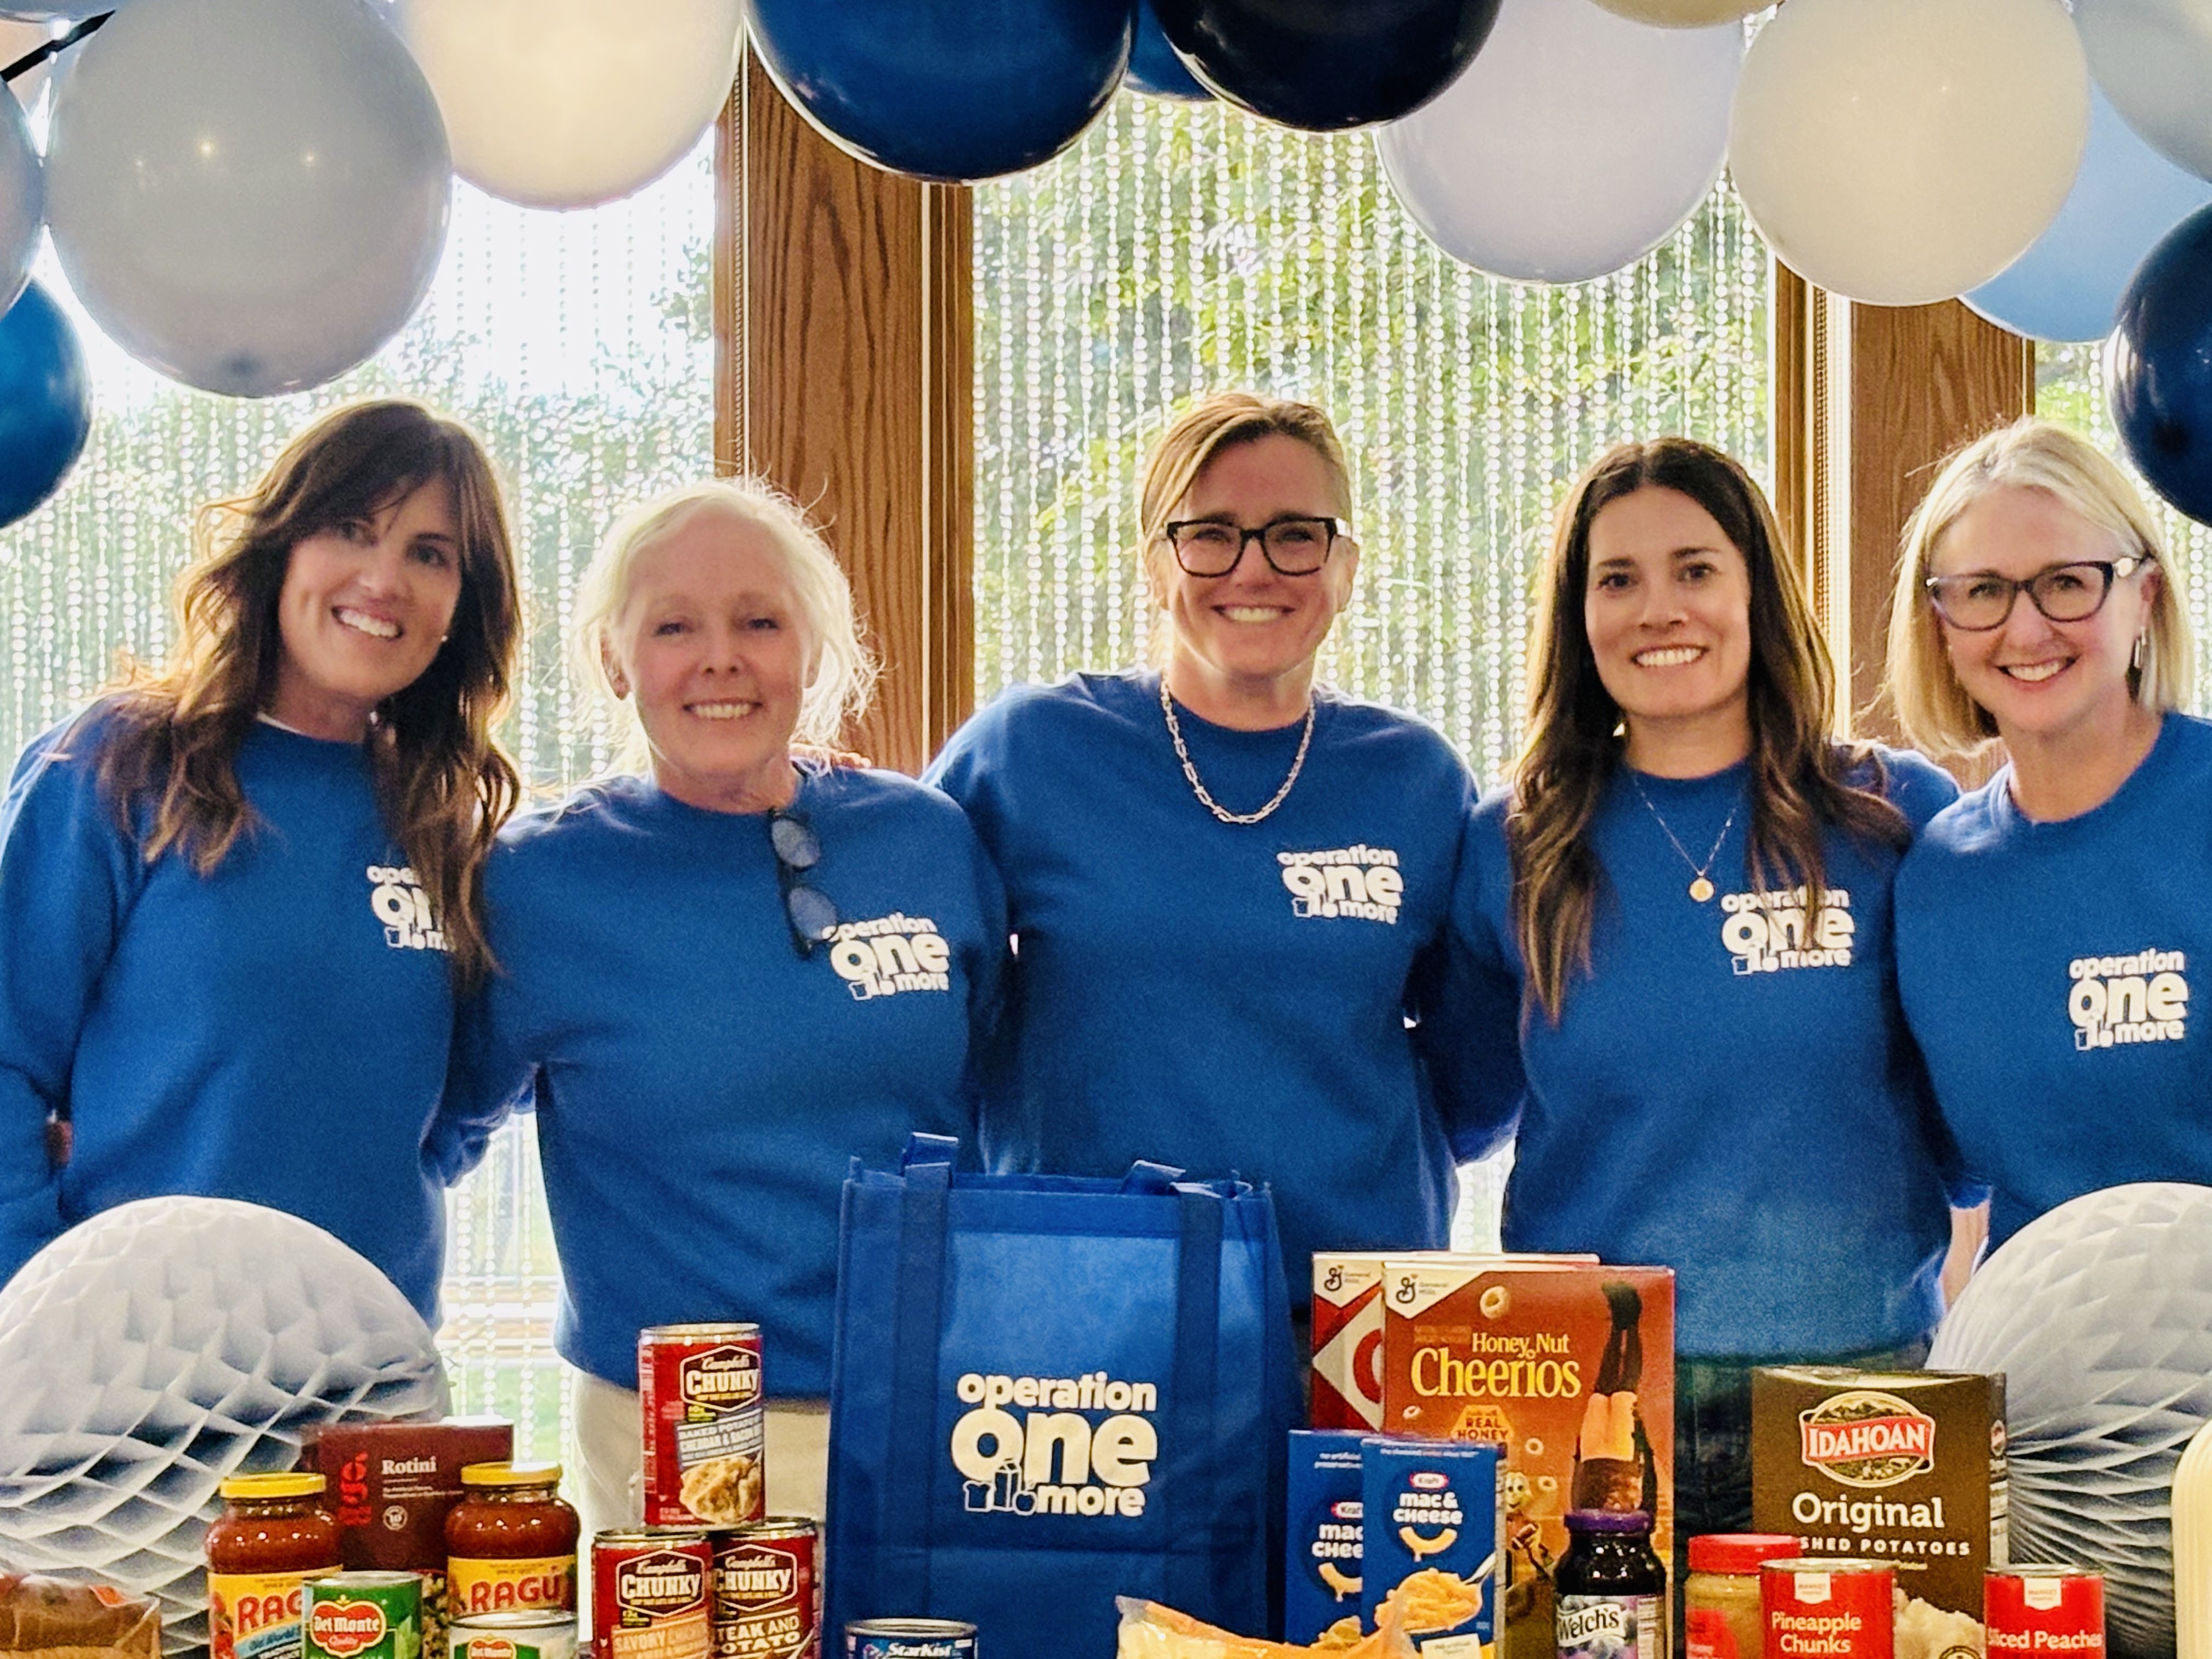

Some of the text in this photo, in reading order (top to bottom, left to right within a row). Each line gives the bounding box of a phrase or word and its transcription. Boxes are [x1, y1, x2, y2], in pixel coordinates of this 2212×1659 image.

[1276, 843, 1399, 867] operation
[1282, 865, 1404, 907] one
[1720, 885, 1850, 912] operaton
[1339, 900, 1398, 926] more
[821, 911, 938, 943] operation
[1722, 907, 1855, 956] one
[830, 933, 950, 981] one
[1780, 948, 1852, 968] more
[2069, 947, 2186, 979] operation
[893, 972, 950, 992] more
[2068, 972, 2189, 1028] one
[2114, 1019, 2185, 1043] more
[1472, 1331, 1530, 1358] Honey
[1536, 1333, 1570, 1354] Nut
[686, 1368, 760, 1396] CHUNKY
[1410, 1346, 1582, 1398] Cheerios
[956, 1371, 1157, 1412] operation
[1457, 1429, 1508, 1440] HONEY
[1465, 1417, 1502, 1428] REAL
[951, 1407, 1158, 1487] one
[1809, 1423, 1926, 1458] IDAHOAN
[381, 1455, 437, 1475] Rotini
[1036, 1484, 1146, 1517] more
[1399, 1492, 1459, 1509] mac &
[1792, 1492, 1945, 1534] Original
[1799, 1537, 1970, 1556] SHED POTATOES
[621, 1573, 701, 1600] CHUNKY
[713, 1568, 792, 1592] CHUNKY
[237, 1589, 302, 1634] RAG
[313, 1615, 380, 1633] Del Monte
[1557, 1607, 1620, 1640] Welch's
[1771, 1611, 1862, 1635] Pineapple
[717, 1622, 765, 1642] TEAK
[768, 1615, 800, 1635] AND
[720, 1630, 800, 1654] OTATO
[888, 1642, 952, 1657] StarKist
[1780, 1634, 1852, 1653] Chunks
